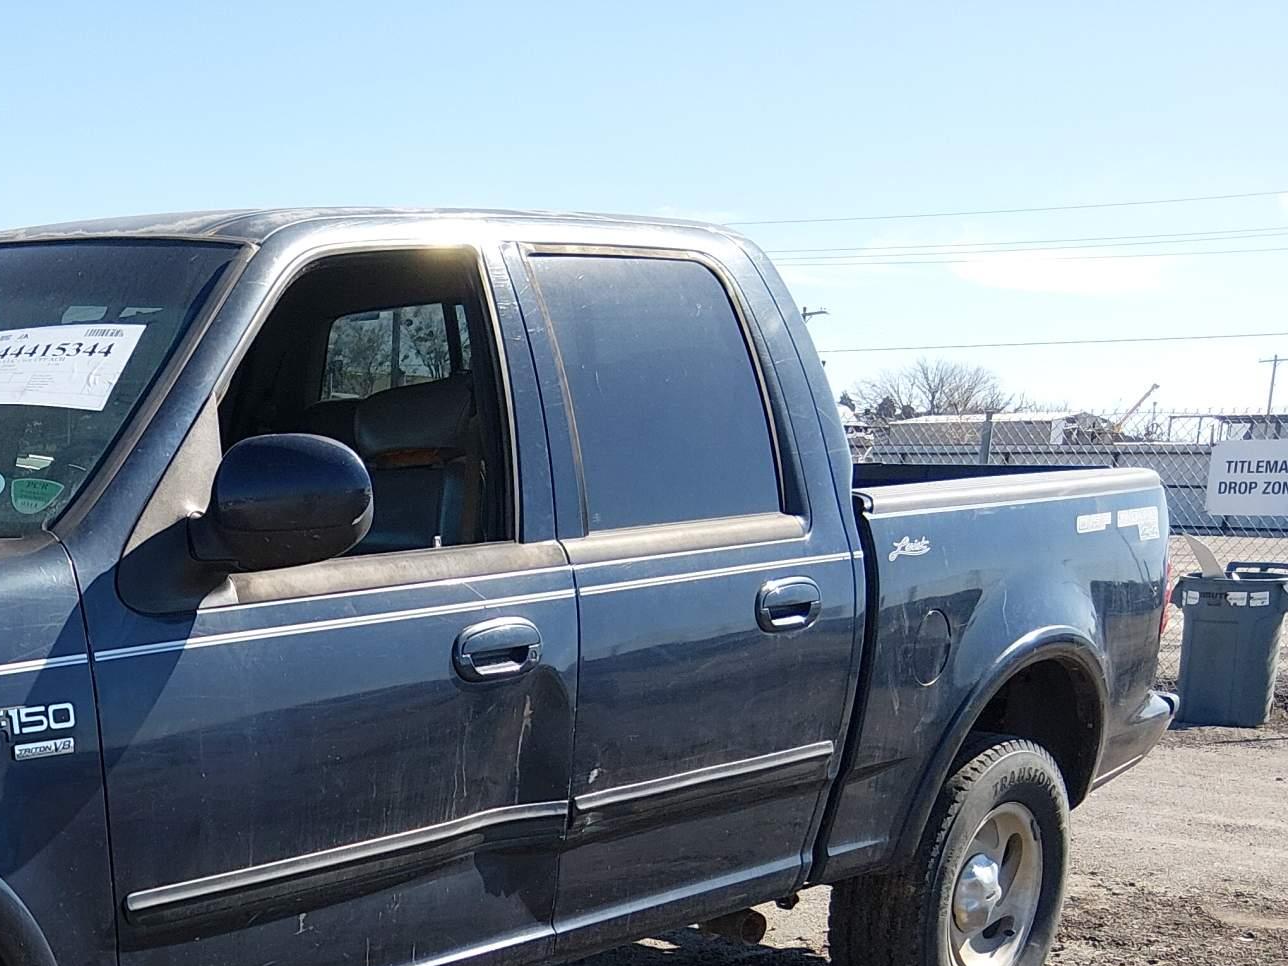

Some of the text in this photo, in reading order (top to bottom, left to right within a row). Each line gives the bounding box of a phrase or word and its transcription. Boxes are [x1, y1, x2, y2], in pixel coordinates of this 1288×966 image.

[1225, 459, 1288, 474] TITLEMA
[1218, 481, 1258, 495] DROP
[53, 739, 72, 753] V8
